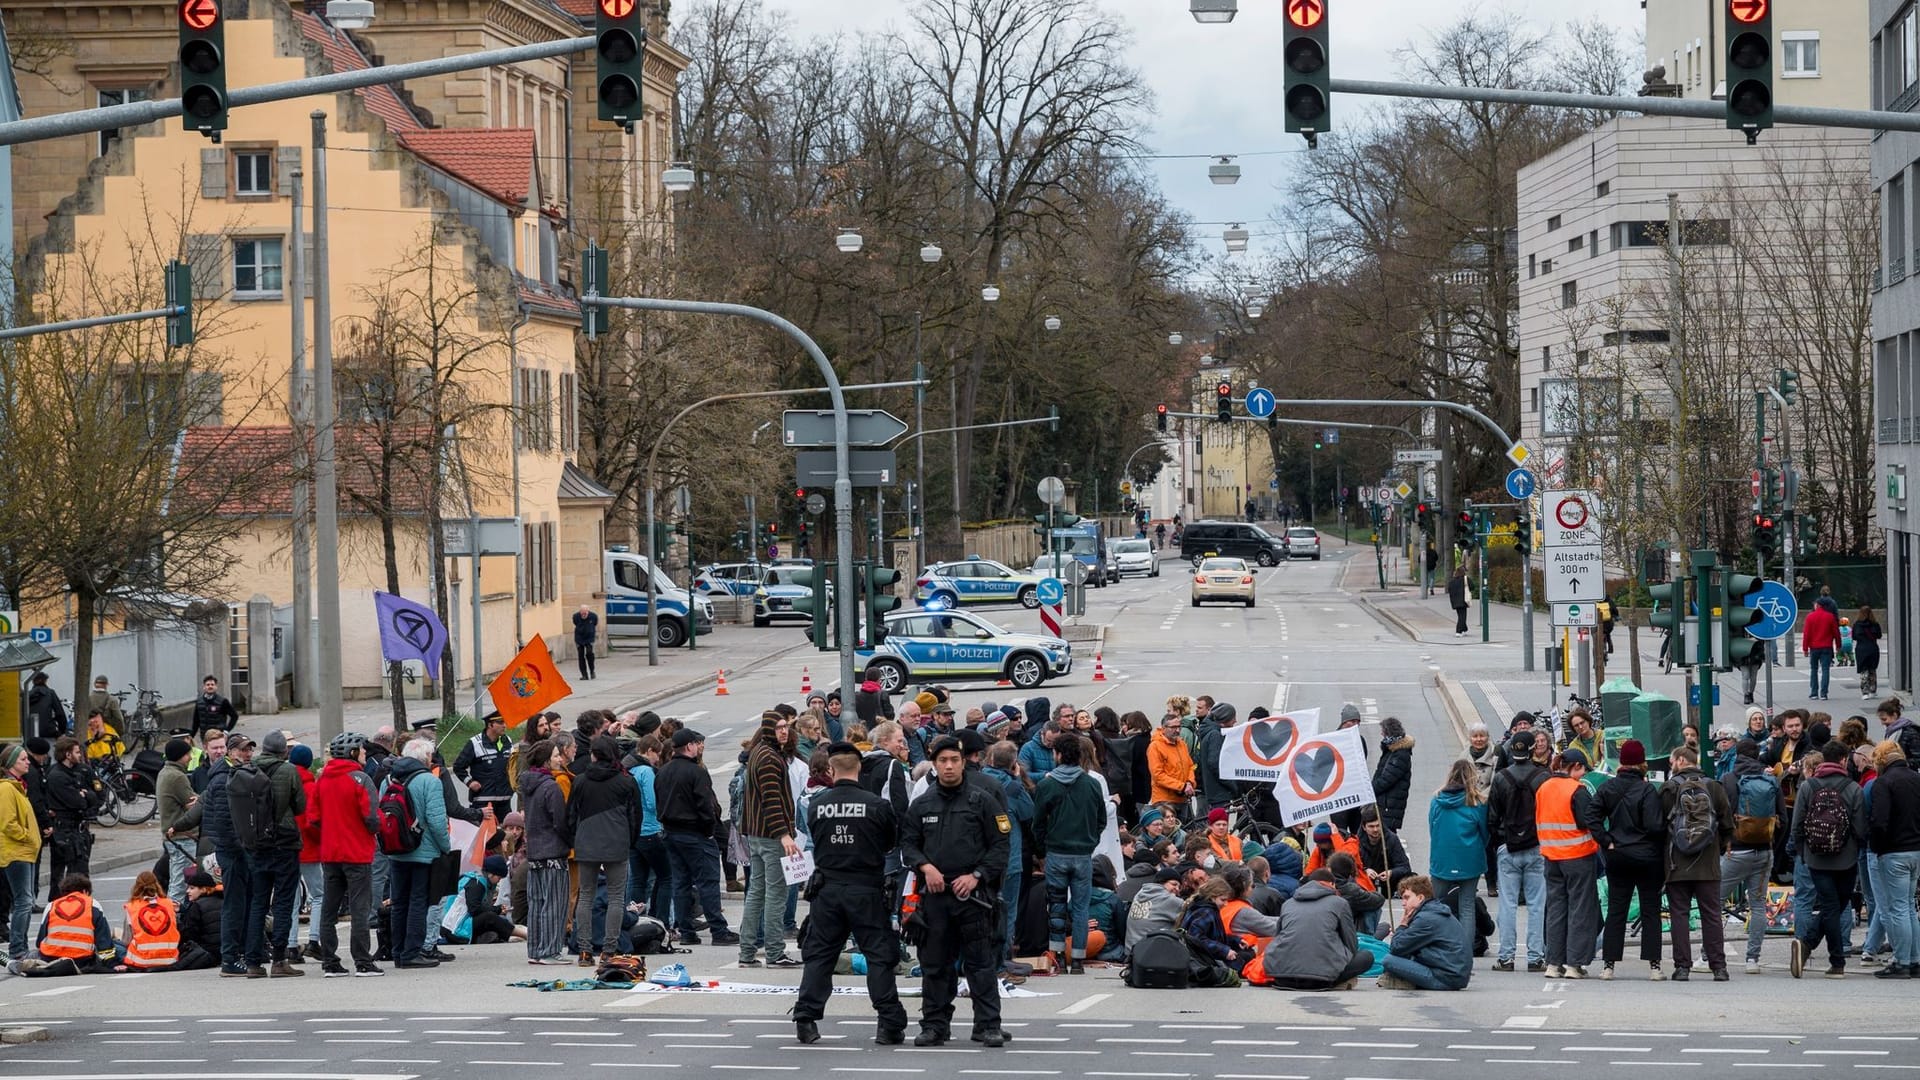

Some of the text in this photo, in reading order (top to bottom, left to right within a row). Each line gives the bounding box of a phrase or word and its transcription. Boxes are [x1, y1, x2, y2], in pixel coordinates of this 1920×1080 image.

[1560, 530, 1586, 540] ZONE
[1554, 552, 1594, 562] Altstadt
[1560, 565, 1578, 575] 300
[984, 582, 1011, 591] POLIZEI
[35, 630, 48, 641] P
[952, 648, 993, 659] POLIZEI
[816, 803, 867, 819] POLIZEI
[835, 825, 848, 835] BY
[830, 834, 855, 844] 6413
